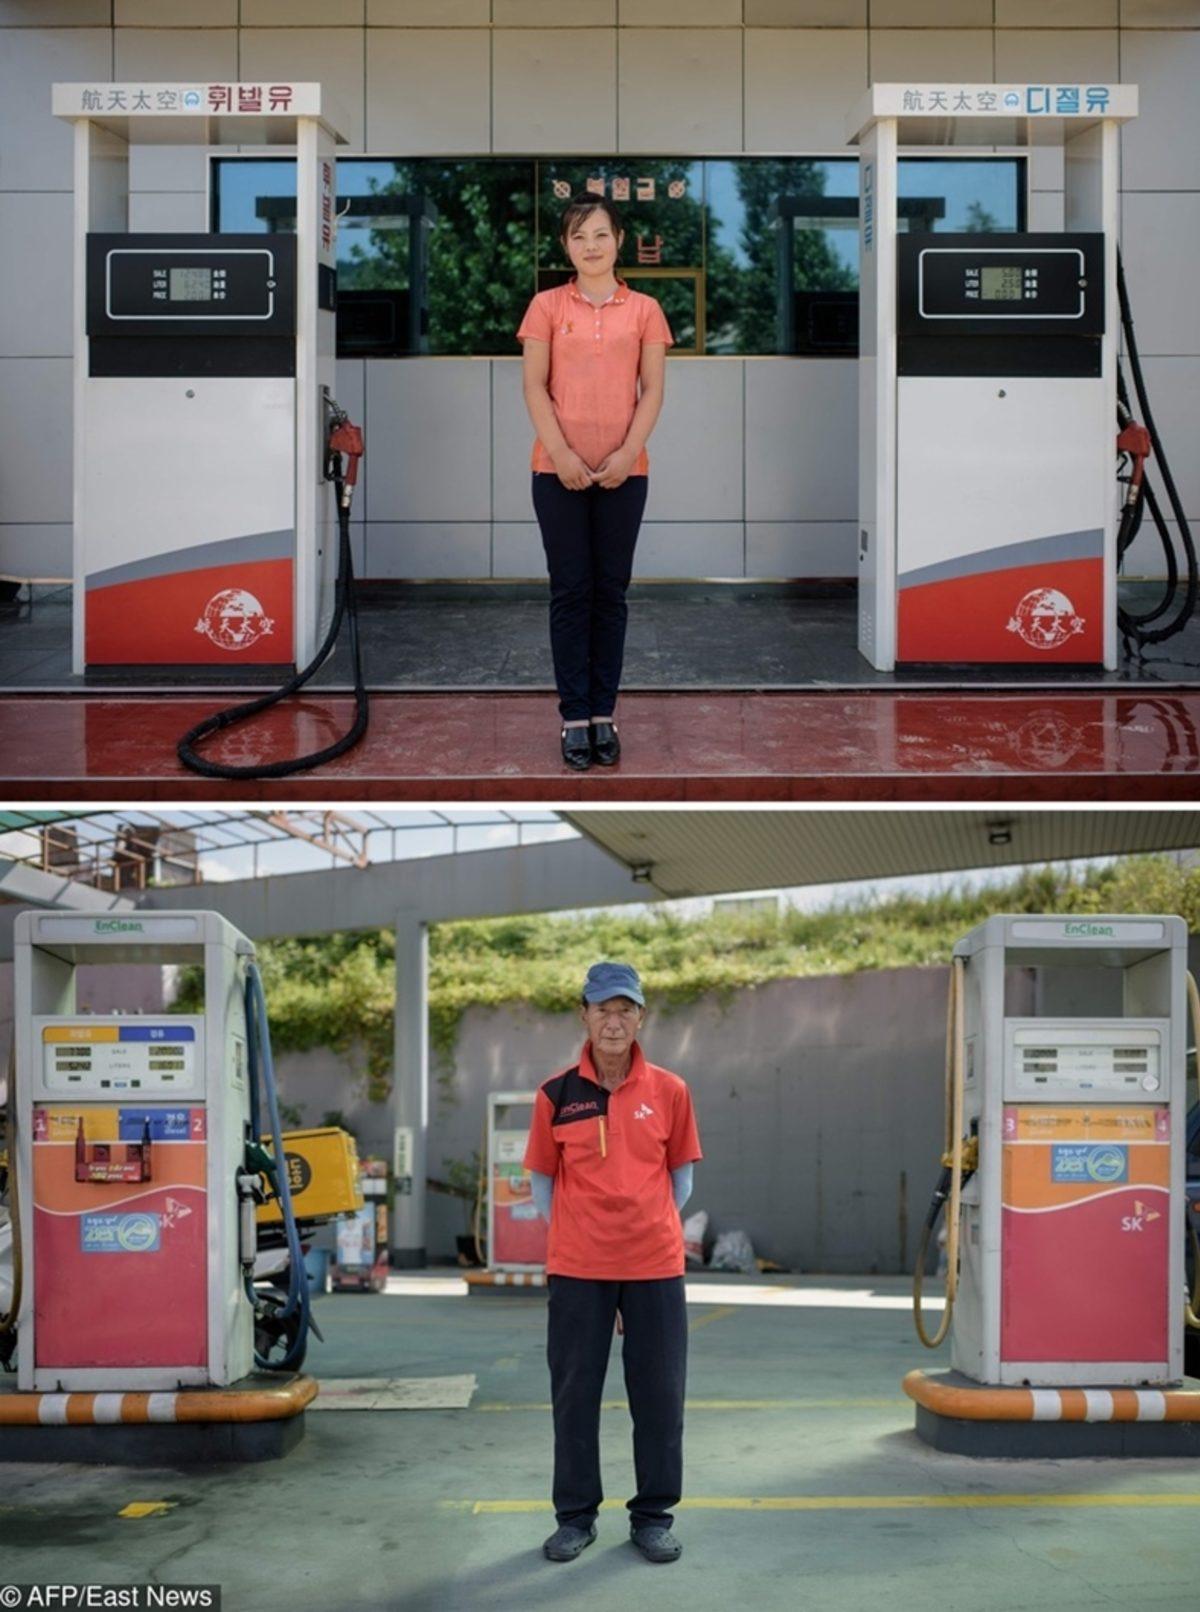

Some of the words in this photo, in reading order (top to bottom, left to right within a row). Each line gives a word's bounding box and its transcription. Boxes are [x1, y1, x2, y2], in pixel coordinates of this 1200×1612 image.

[81, 89, 178, 111] 航天太空
[207, 85, 293, 112] 휘발유
[902, 89, 998, 112] 航天太空
[94, 919, 144, 934] EnClean
[1063, 921, 1115, 937] EnClean
[36, 1119, 46, 1132] 1
[193, 1118, 203, 1132] 2
[1005, 1118, 1016, 1132] 3
[1121, 1216, 1143, 1232] SK
